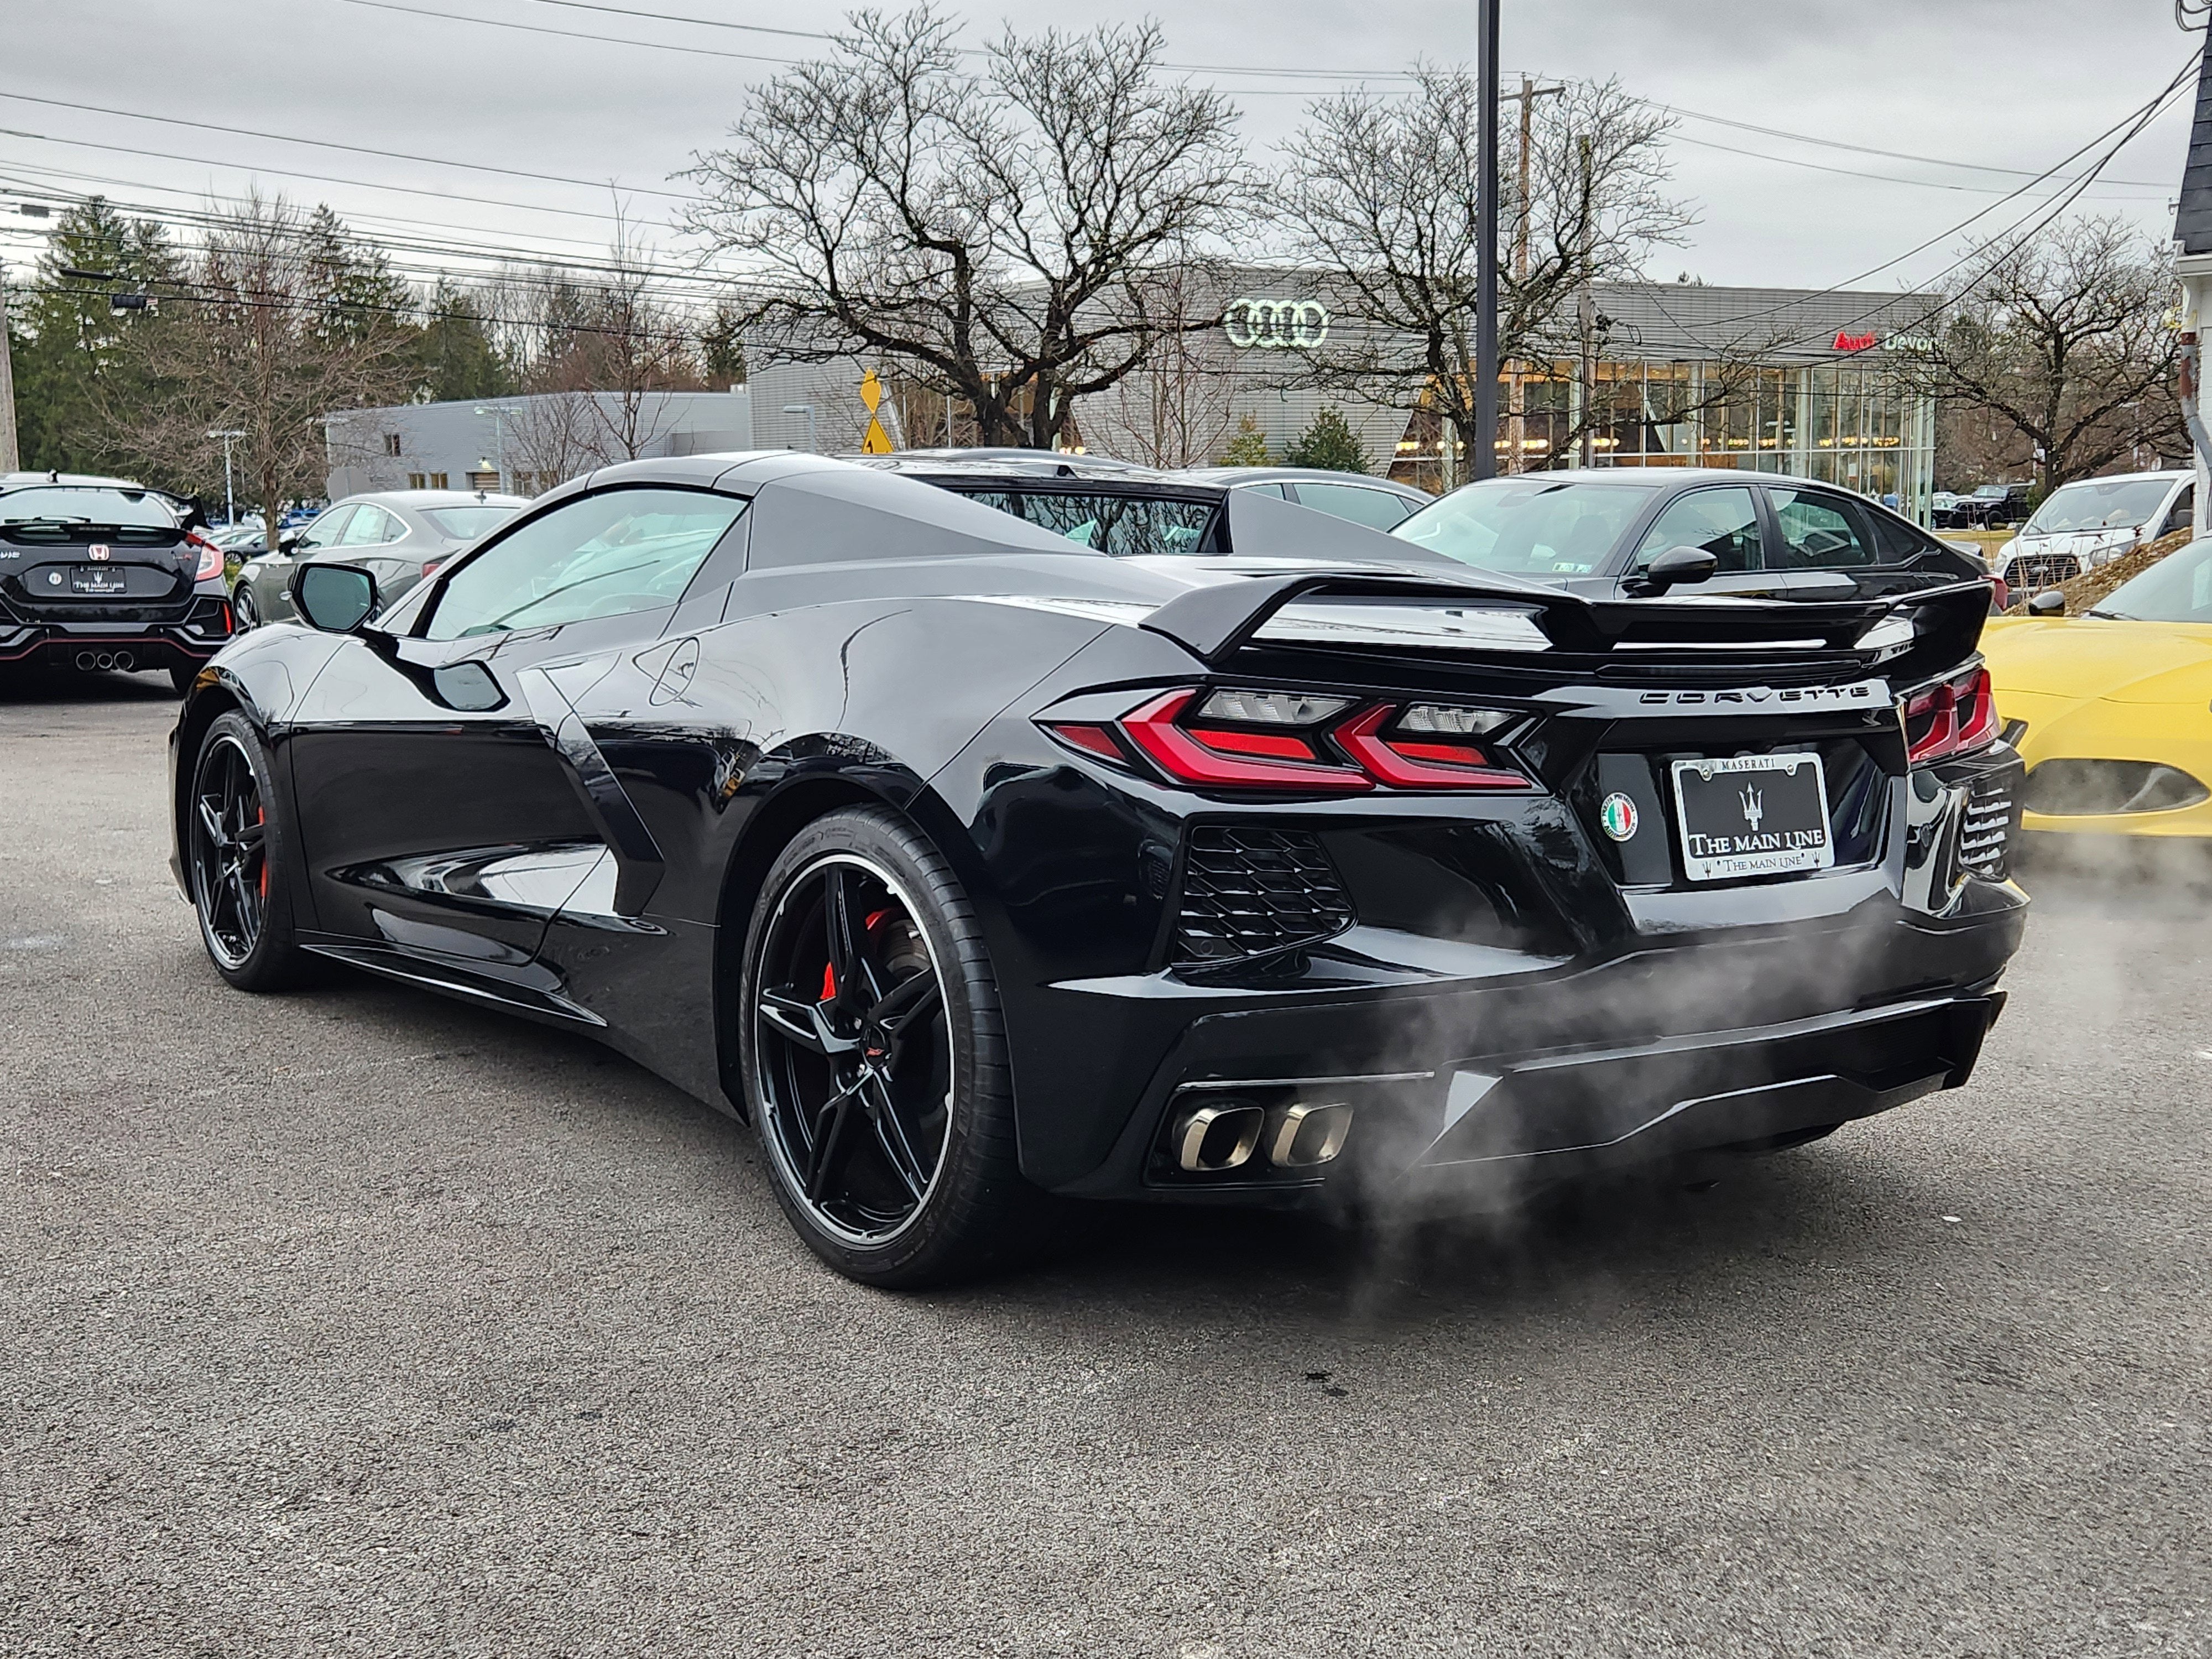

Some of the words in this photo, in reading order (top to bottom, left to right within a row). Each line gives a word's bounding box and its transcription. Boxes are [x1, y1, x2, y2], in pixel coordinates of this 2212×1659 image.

[1639, 686, 1870, 705] CORVETTE
[1721, 758, 1776, 770] MASERATI
[1688, 833, 1732, 856] THE
[1733, 833, 1781, 852] MAIN
[1784, 829, 1824, 851] LINE
[1723, 859, 1747, 872] THE
[1749, 857, 1778, 870] MAIN
[1780, 855, 1802, 868] LINE
